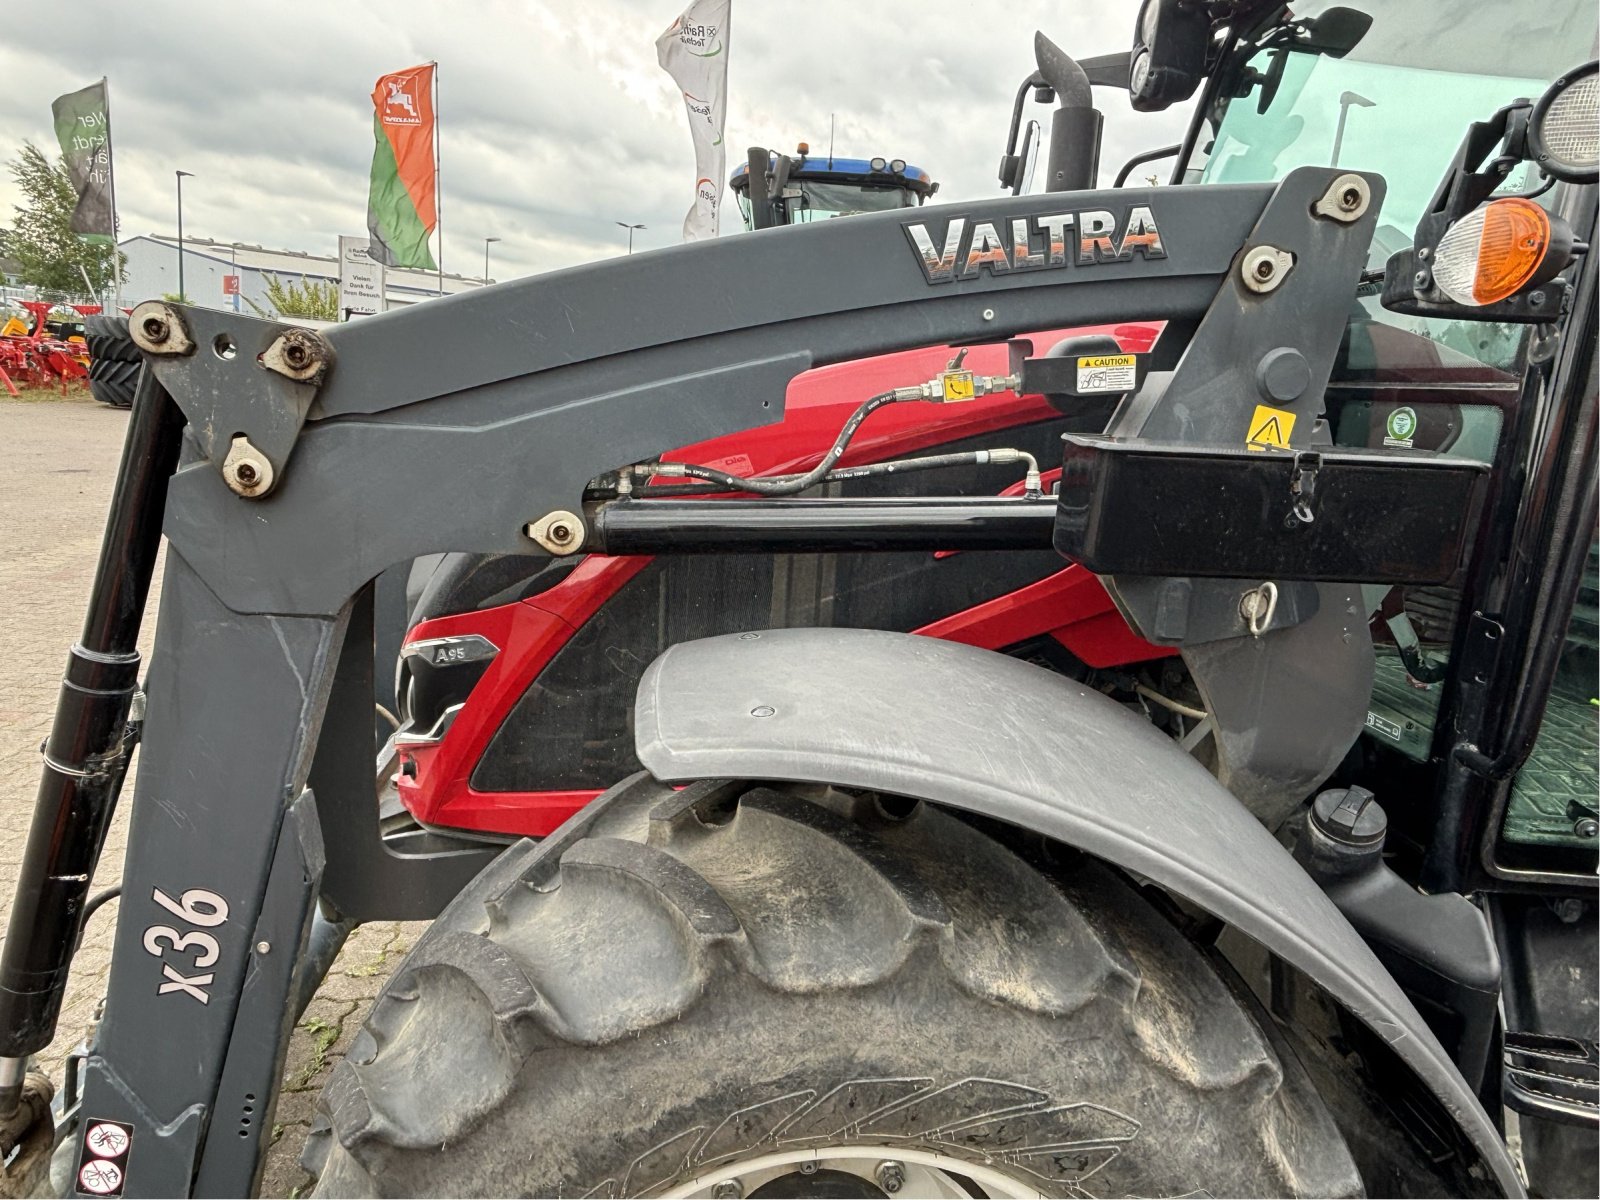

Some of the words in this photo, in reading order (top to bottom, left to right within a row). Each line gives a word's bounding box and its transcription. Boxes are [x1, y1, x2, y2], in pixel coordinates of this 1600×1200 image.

[907, 206, 1165, 281] VALTRA
[1094, 357, 1129, 367] CAUTION
[435, 647, 465, 663] A95
[142, 886, 230, 1006] x36
